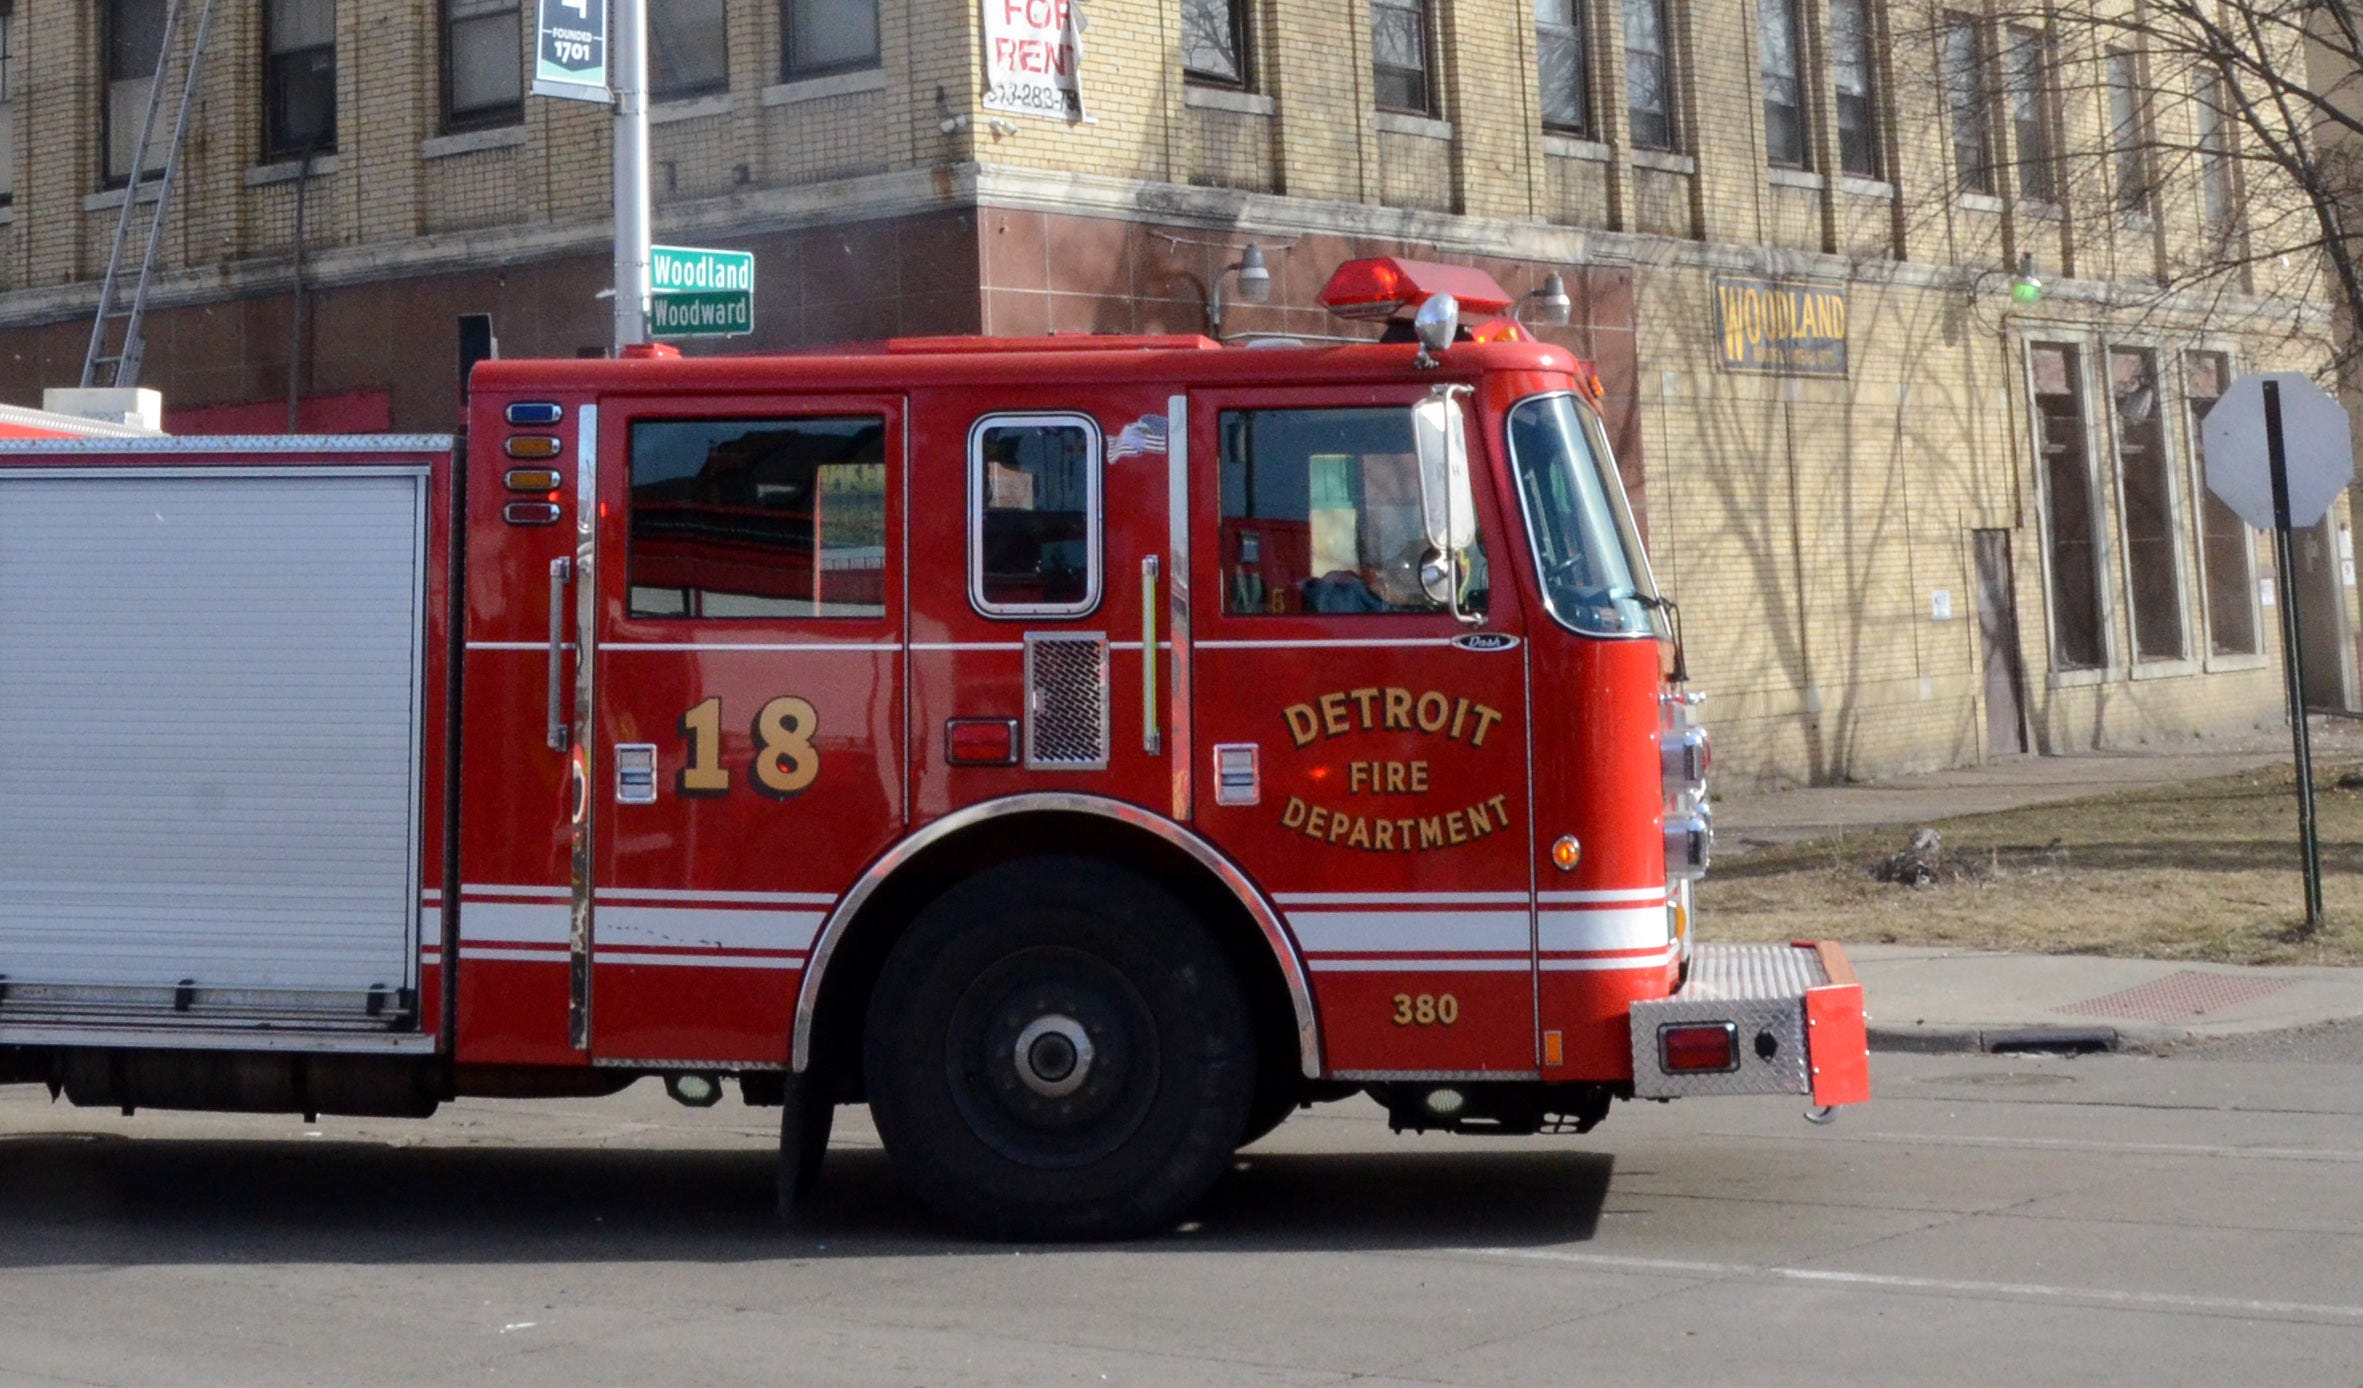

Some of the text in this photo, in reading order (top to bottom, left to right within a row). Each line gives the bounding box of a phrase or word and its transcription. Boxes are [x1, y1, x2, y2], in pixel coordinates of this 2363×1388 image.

[552, 26, 593, 43] FOUNDED
[554, 41, 590, 64] 1701
[653, 254, 749, 289] Woodland
[654, 297, 747, 327] Woodward
[1718, 285, 1846, 362] WOODLAND
[1468, 636, 1501, 649] Dash
[1281, 686, 1503, 748] DETROIT
[677, 695, 819, 798] 18
[1349, 760, 1429, 793] FIRE
[1281, 794, 1509, 850] DEPARTMENT
[1392, 993, 1458, 1025] 380
